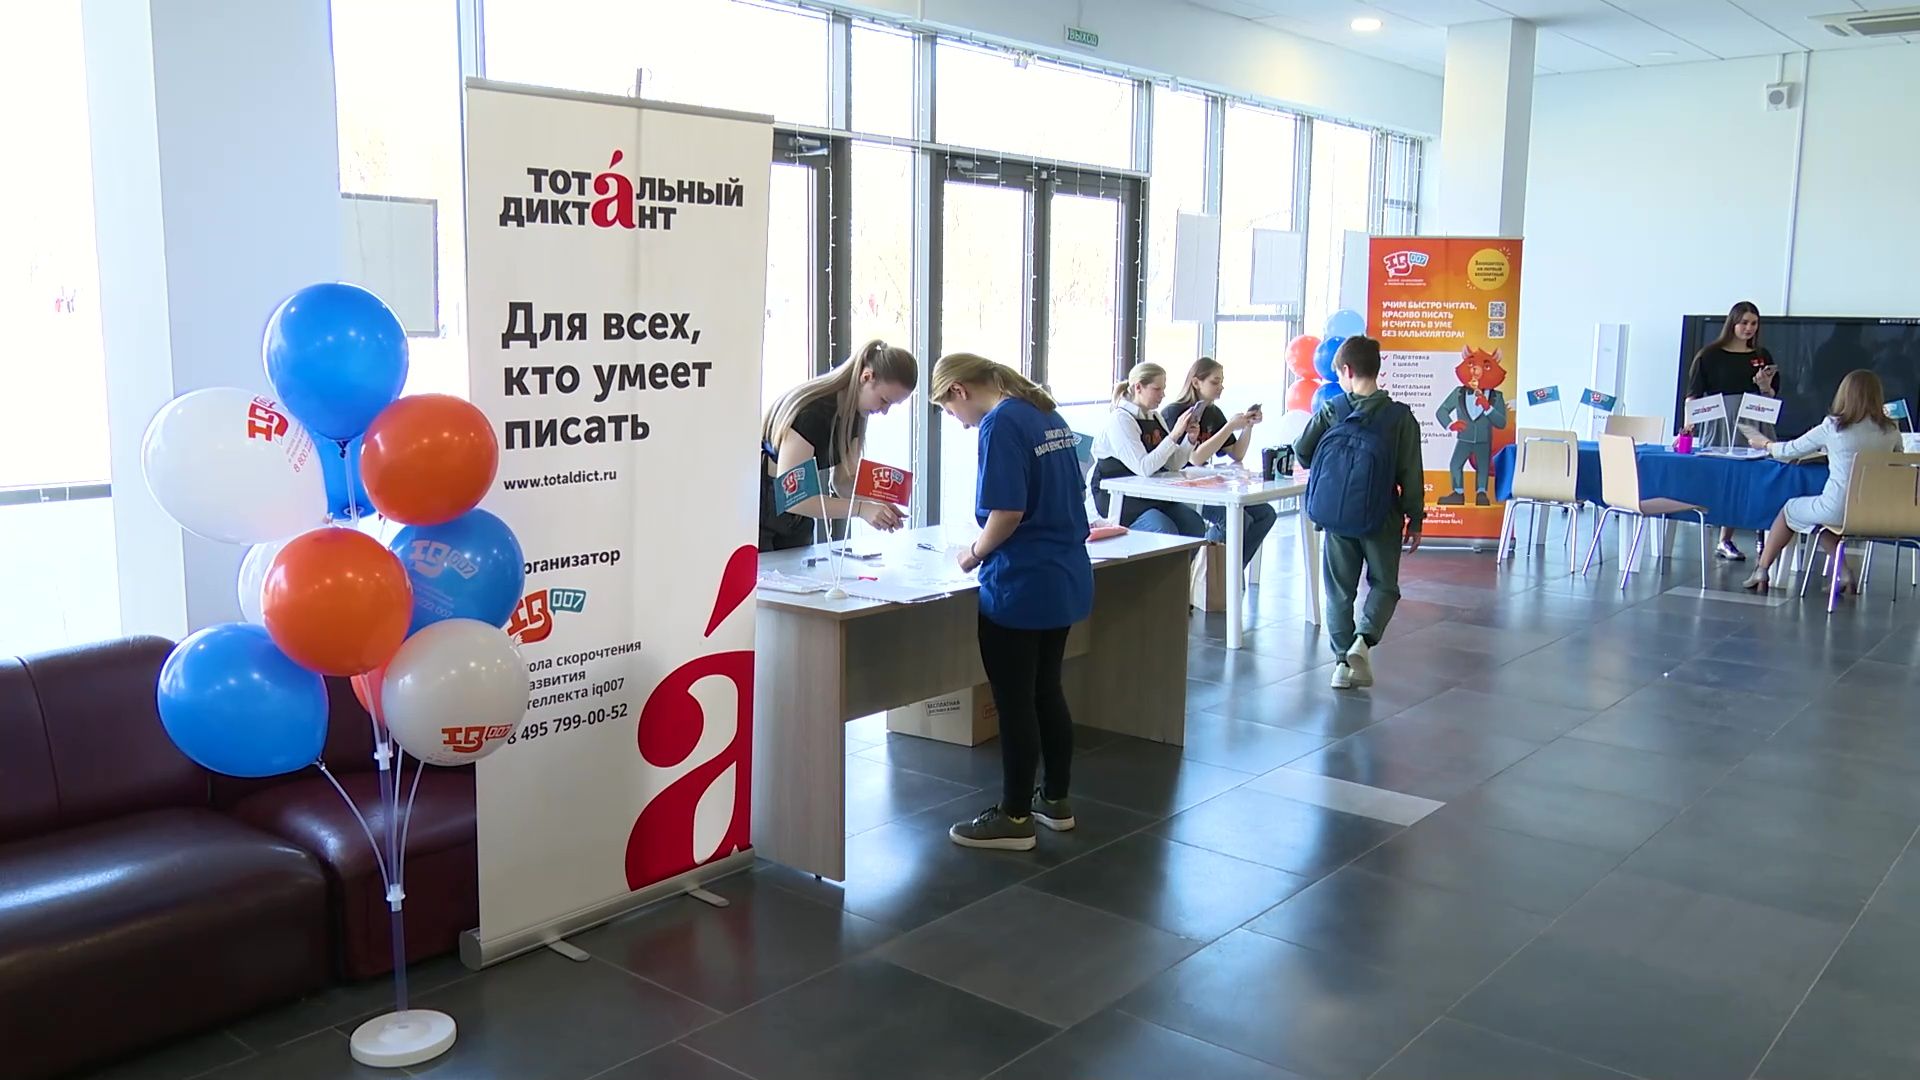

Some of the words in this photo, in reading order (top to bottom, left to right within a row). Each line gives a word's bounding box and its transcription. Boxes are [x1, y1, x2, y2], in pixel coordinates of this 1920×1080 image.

[1069, 29, 1098, 46] ВЫХОД
[1382, 301, 1407, 309] УЧИМ
[1408, 301, 1442, 309] БЫСТРО
[1443, 302, 1477, 310] ЧИТАТЬ,
[1382, 311, 1421, 319] КРАСИВО
[1421, 311, 1454, 319] ПИСАТЬ
[501, 301, 587, 349] Для
[603, 310, 701, 345] всех,
[1381, 330, 1397, 338] БЕЗ
[1398, 330, 1464, 338] КАЛЬКУЛЯТОРА!
[1382, 320, 1388, 328] И
[1389, 320, 1426, 328] СЧИТАТЬ
[1427, 320, 1433, 328] В
[1434, 320, 1453, 328] УМЕ
[504, 363, 580, 396] кто
[593, 361, 712, 403] умеет
[505, 413, 650, 450] писать
[504, 469, 617, 491] www.totaldict.ru
[1424, 484, 1434, 492] 52
[524, 549, 621, 575] рганизатор
[552, 590, 585, 609] 007
[527, 657, 553, 673] ола
[556, 640, 641, 667] скорочтения
[528, 670, 586, 691] азвития
[592, 677, 625, 697] iq007
[521, 721, 548, 742] 495
[553, 703, 628, 734] 799-00-52
